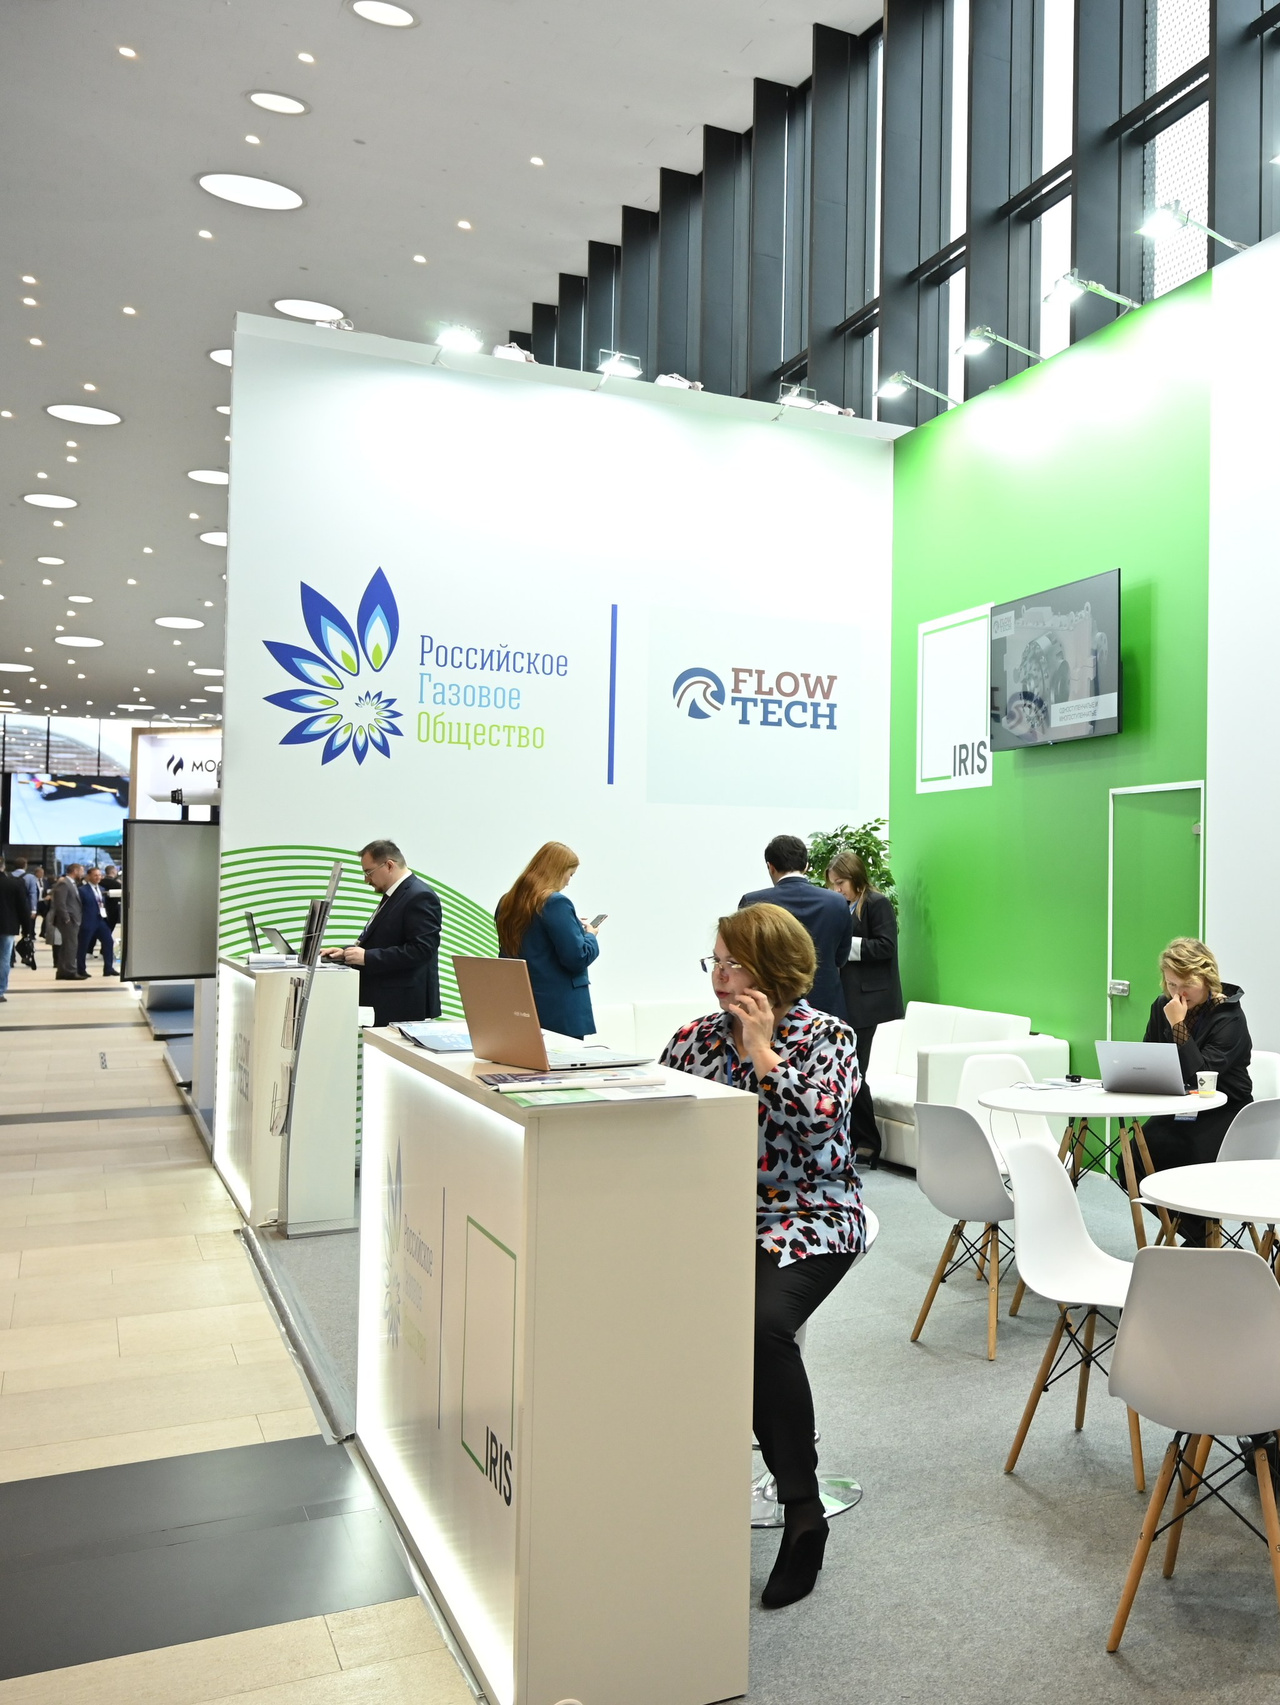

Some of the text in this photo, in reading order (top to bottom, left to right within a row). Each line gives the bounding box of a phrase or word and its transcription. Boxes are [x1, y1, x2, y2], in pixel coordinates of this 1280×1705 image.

[419, 634, 568, 677] Российское
[418, 672, 521, 710] Газовое
[731, 667, 838, 700] FLOW
[417, 711, 545, 751] Общество
[731, 696, 837, 730] TECH
[953, 740, 988, 777] IRIS
[485, 1425, 512, 1507] IRIS
